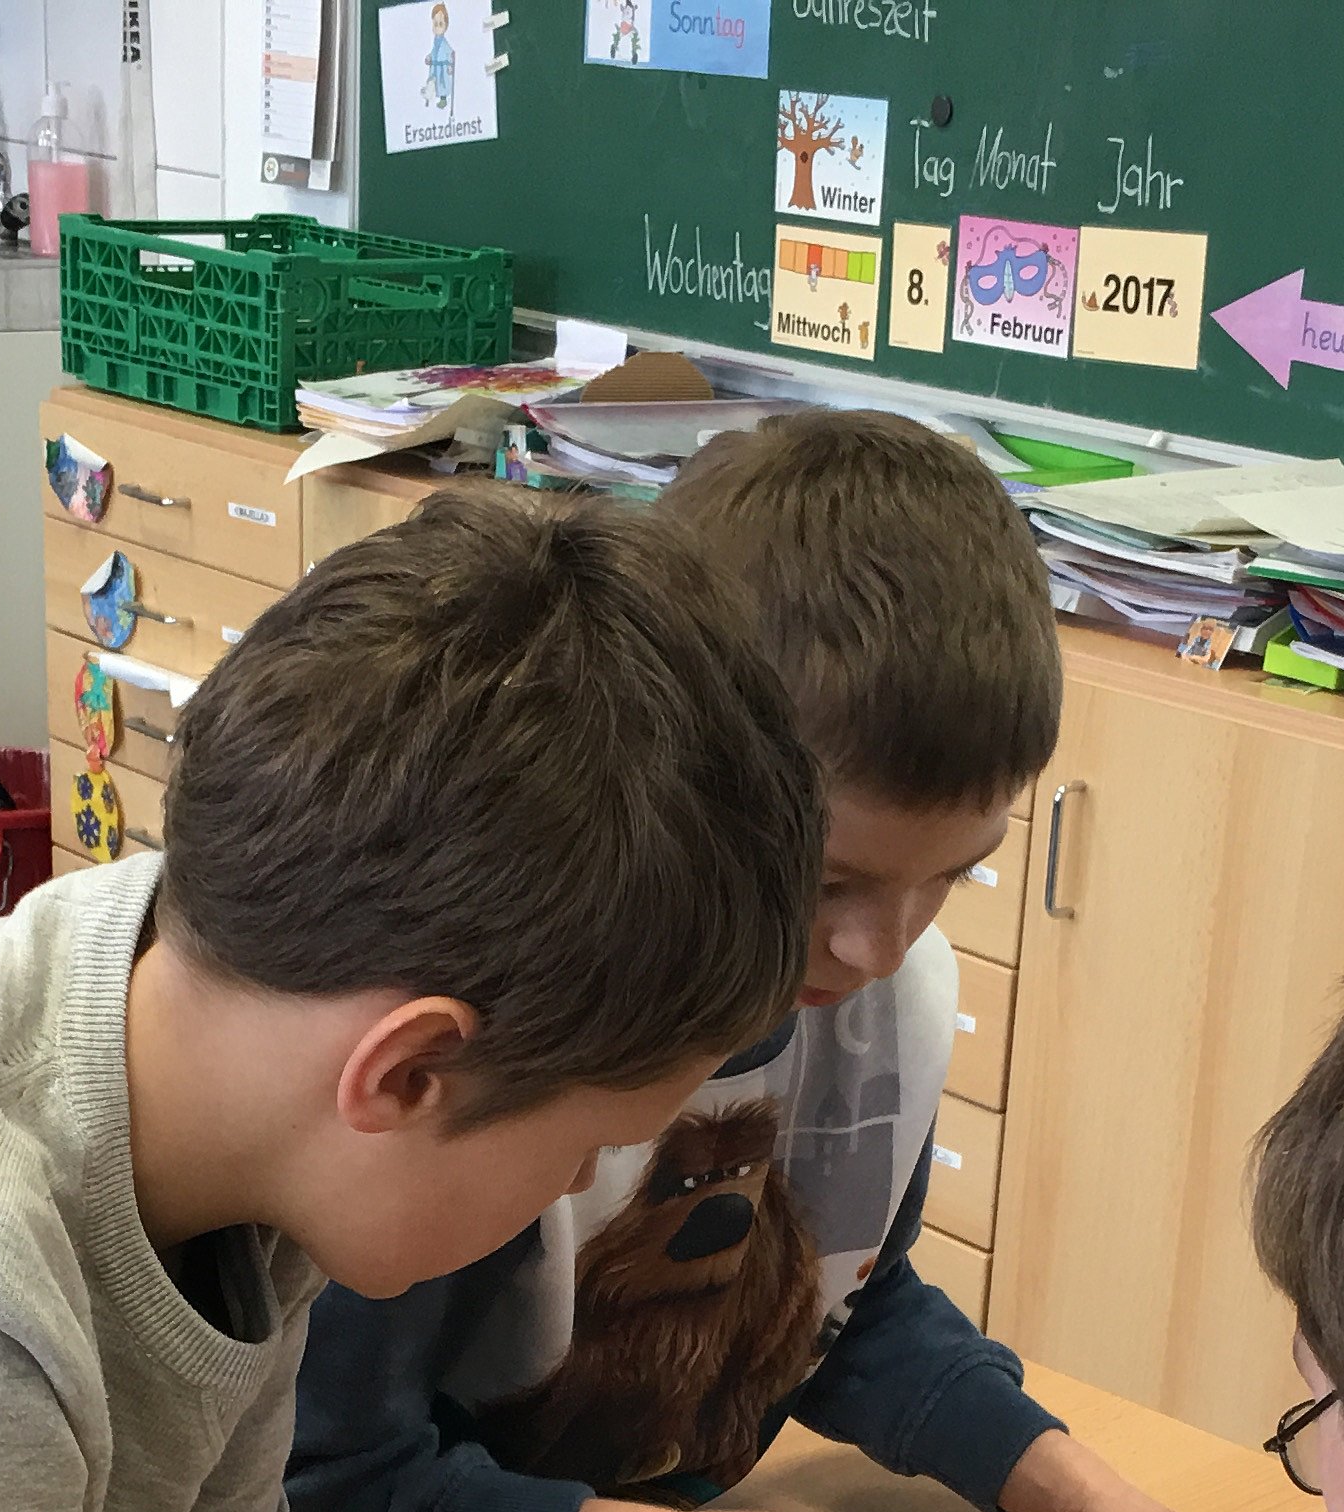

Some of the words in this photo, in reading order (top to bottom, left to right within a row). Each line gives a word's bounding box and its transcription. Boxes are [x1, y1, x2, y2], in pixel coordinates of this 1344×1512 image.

[128, 1, 141, 63] IKEA
[669, 0, 745, 48] Sonntag
[404, 115, 483, 145] Ersatzdienst
[910, 118, 955, 197] Tag
[969, 121, 1057, 195] Monat
[1097, 133, 1184, 214] Jahr
[821, 186, 876, 213] Winter
[644, 213, 772, 330] Wochentag
[907, 269, 929, 305] 8.
[1102, 273, 1176, 316] 2017
[777, 312, 851, 344] Mittwoch
[990, 313, 1064, 346] Februar
